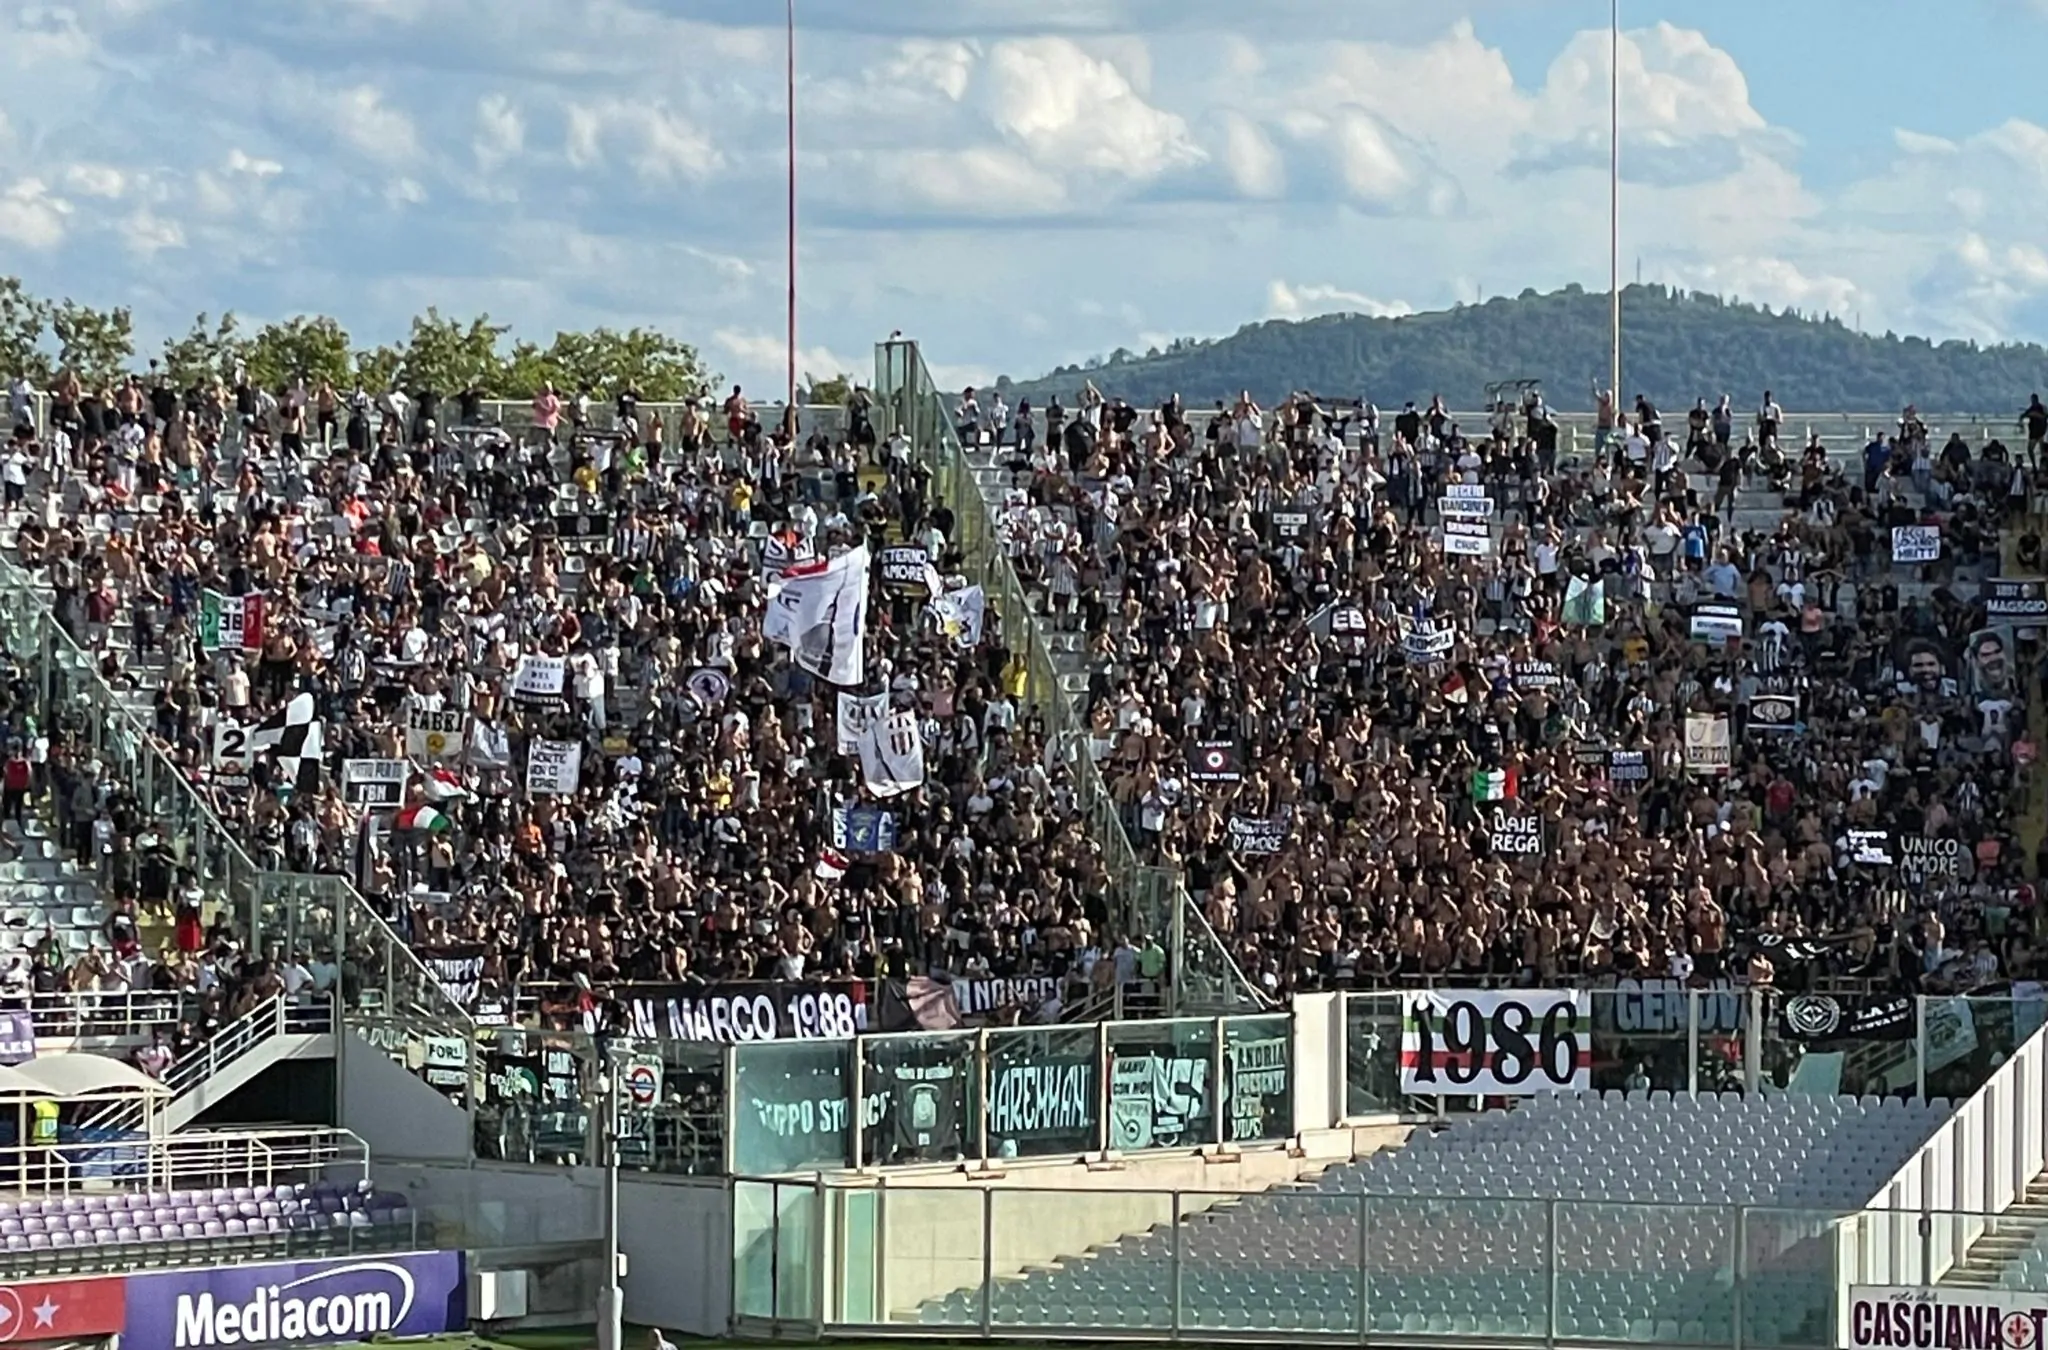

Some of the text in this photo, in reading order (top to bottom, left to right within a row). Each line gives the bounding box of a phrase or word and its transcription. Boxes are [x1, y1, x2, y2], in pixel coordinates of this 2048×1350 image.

[882, 566, 925, 583] AMORE
[220, 729, 246, 758] 2
[1900, 835, 1958, 856] UNICO
[1900, 853, 1959, 876] AMORE
[666, 995, 777, 1042] MARCO
[788, 992, 855, 1039] 1988
[1411, 1000, 1579, 1084] 1986
[175, 1285, 392, 1347] Mediacom
[1854, 1301, 2003, 1350] CASCIANA
